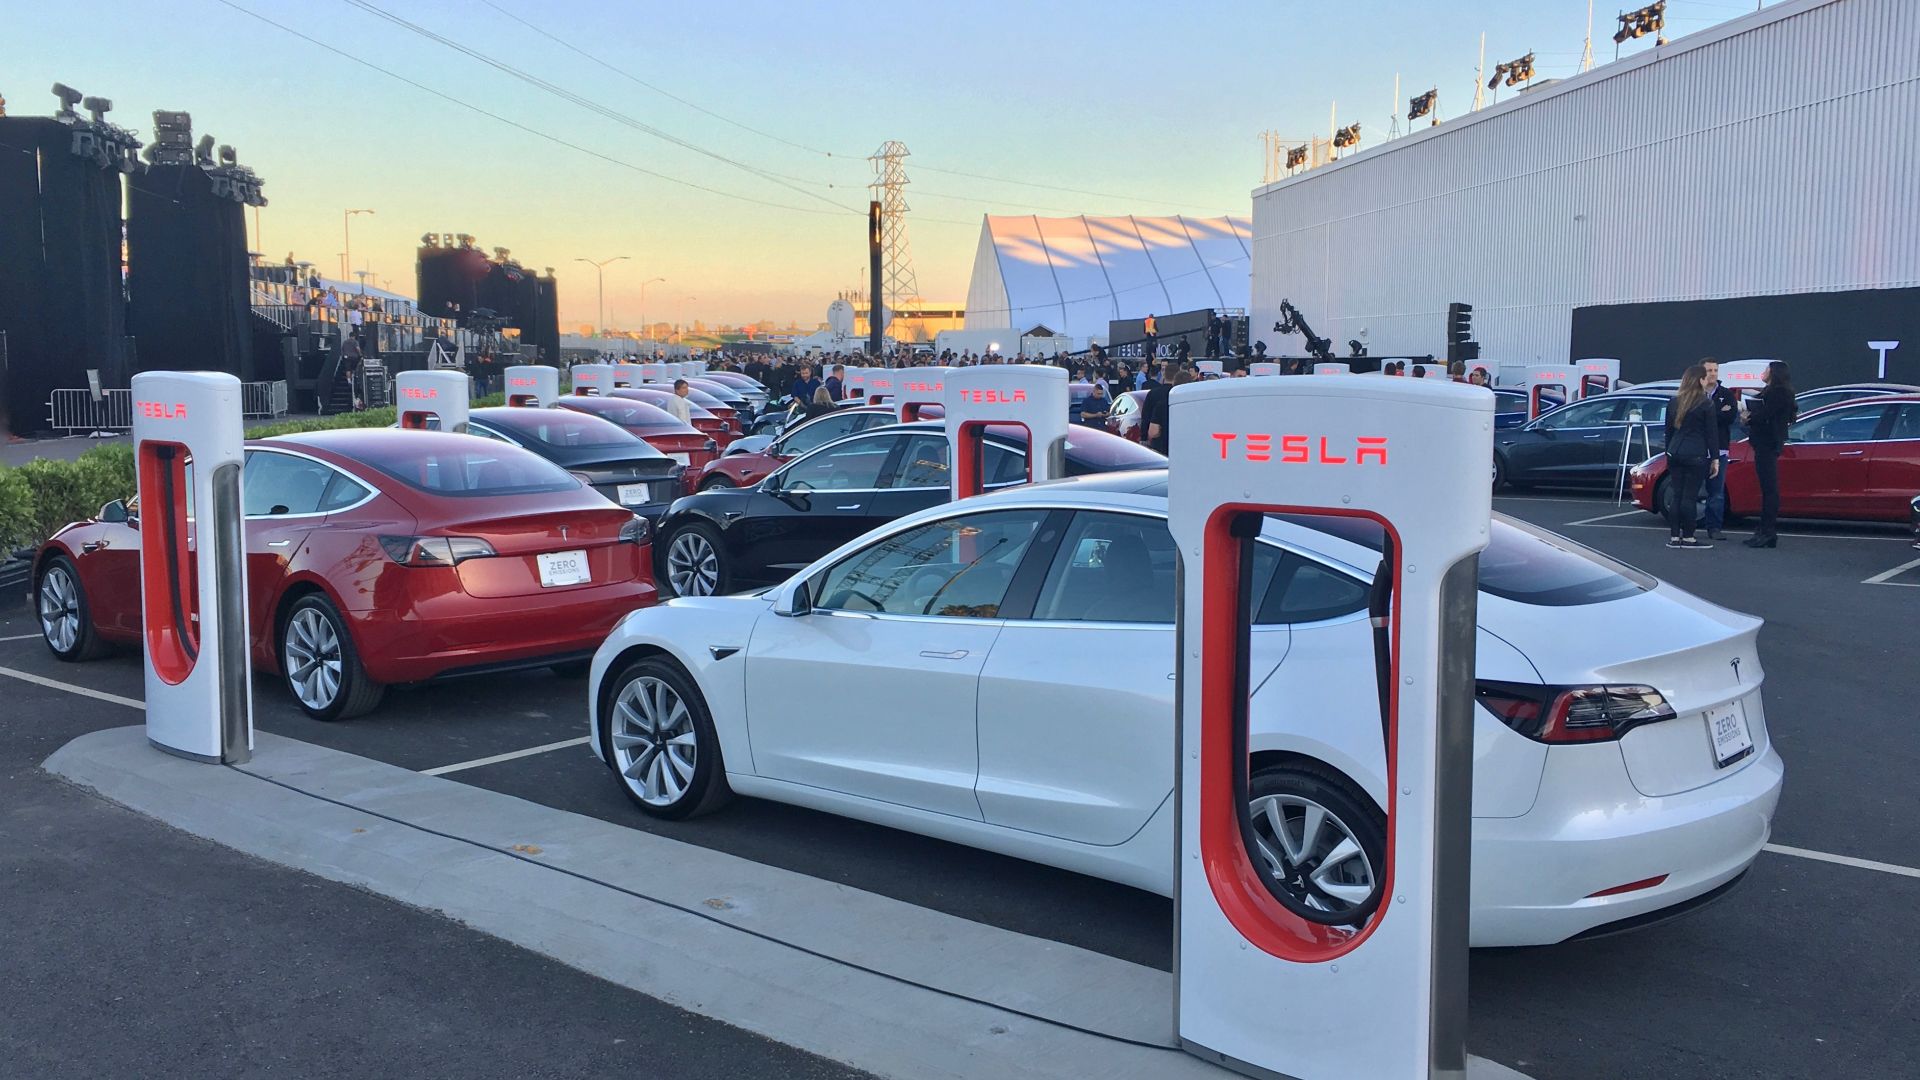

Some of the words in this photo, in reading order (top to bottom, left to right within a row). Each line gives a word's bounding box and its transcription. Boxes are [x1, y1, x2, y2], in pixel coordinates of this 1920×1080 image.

[871, 380, 892, 388] TESL
[903, 383, 943, 392] TESLA
[401, 388, 438, 399] TESLA
[960, 390, 1026, 403] TESLA
[137, 401, 187, 419] TESLA
[1211, 433, 1389, 465] TESLA
[550, 560, 577, 570] ZERO
[1716, 714, 1737, 736] ZERO
[1717, 728, 1741, 746] EMISSIONS
